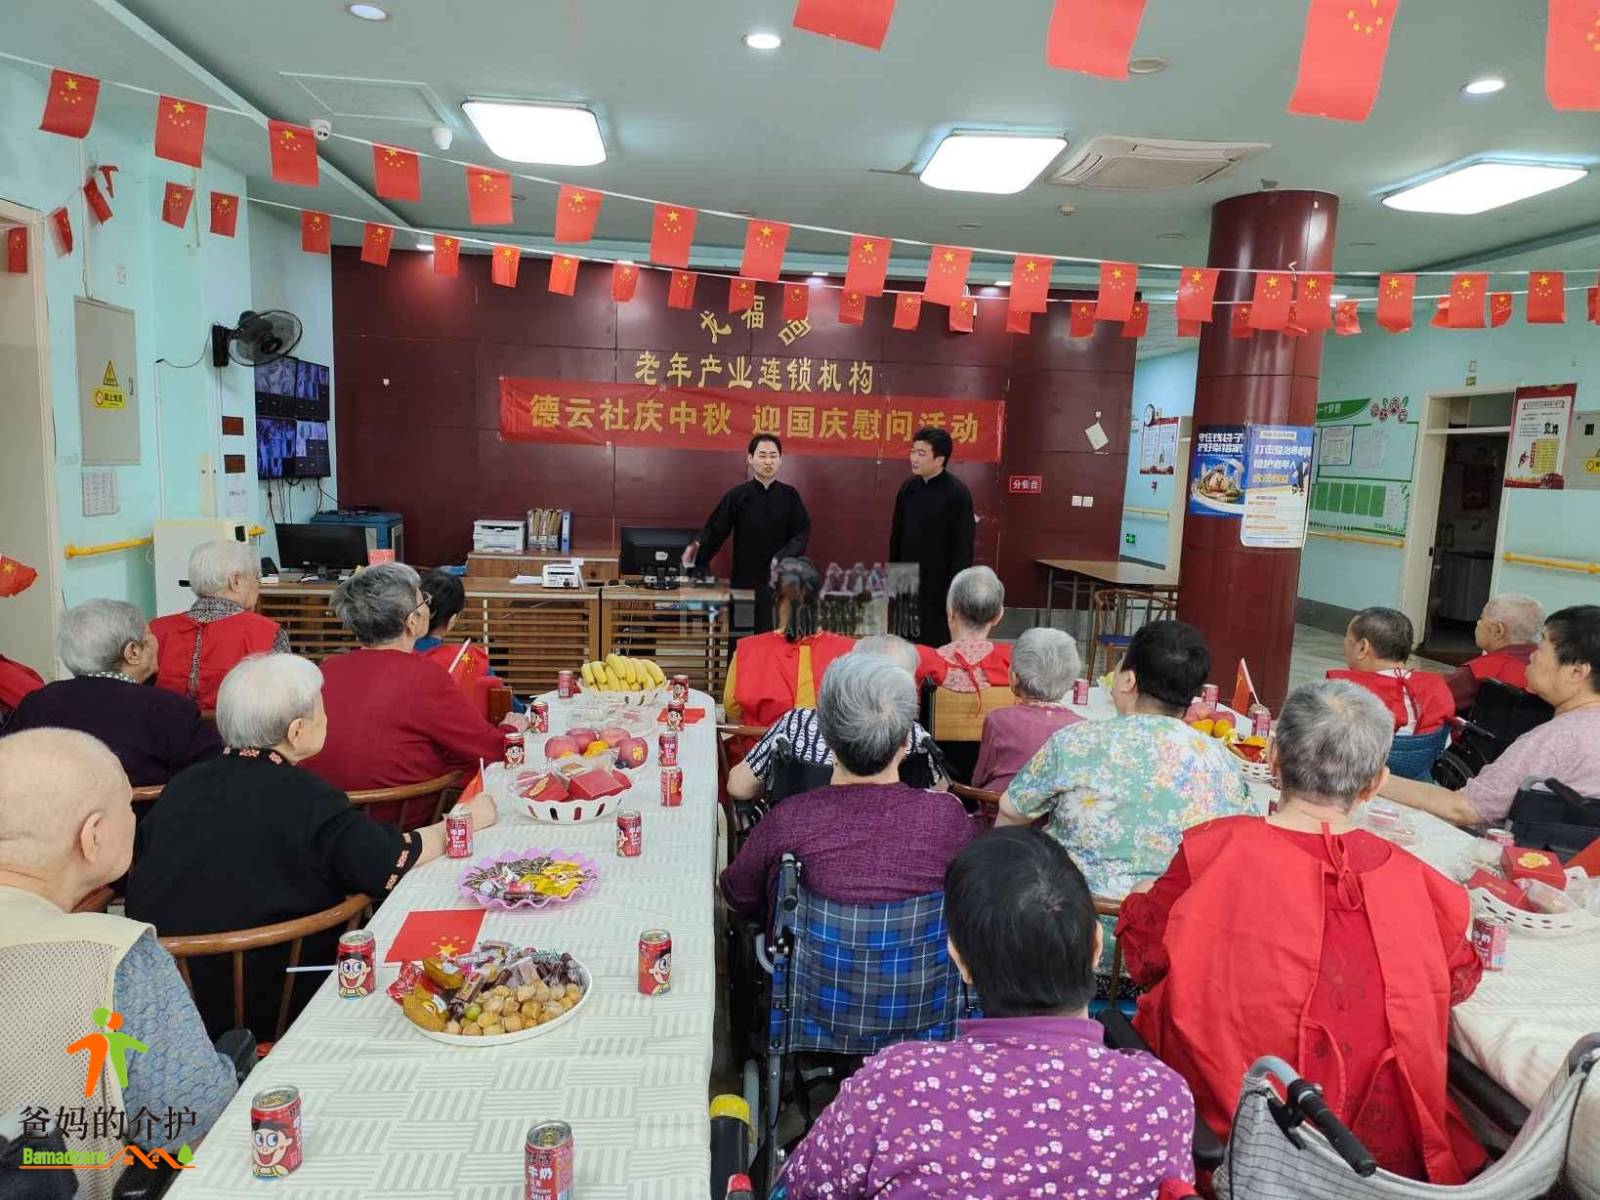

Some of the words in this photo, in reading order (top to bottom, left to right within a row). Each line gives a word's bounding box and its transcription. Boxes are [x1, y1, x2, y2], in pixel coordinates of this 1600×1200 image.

[634, 351, 874, 395] 老年产业连锁机构
[530, 394, 732, 436] 德云社庆中秋
